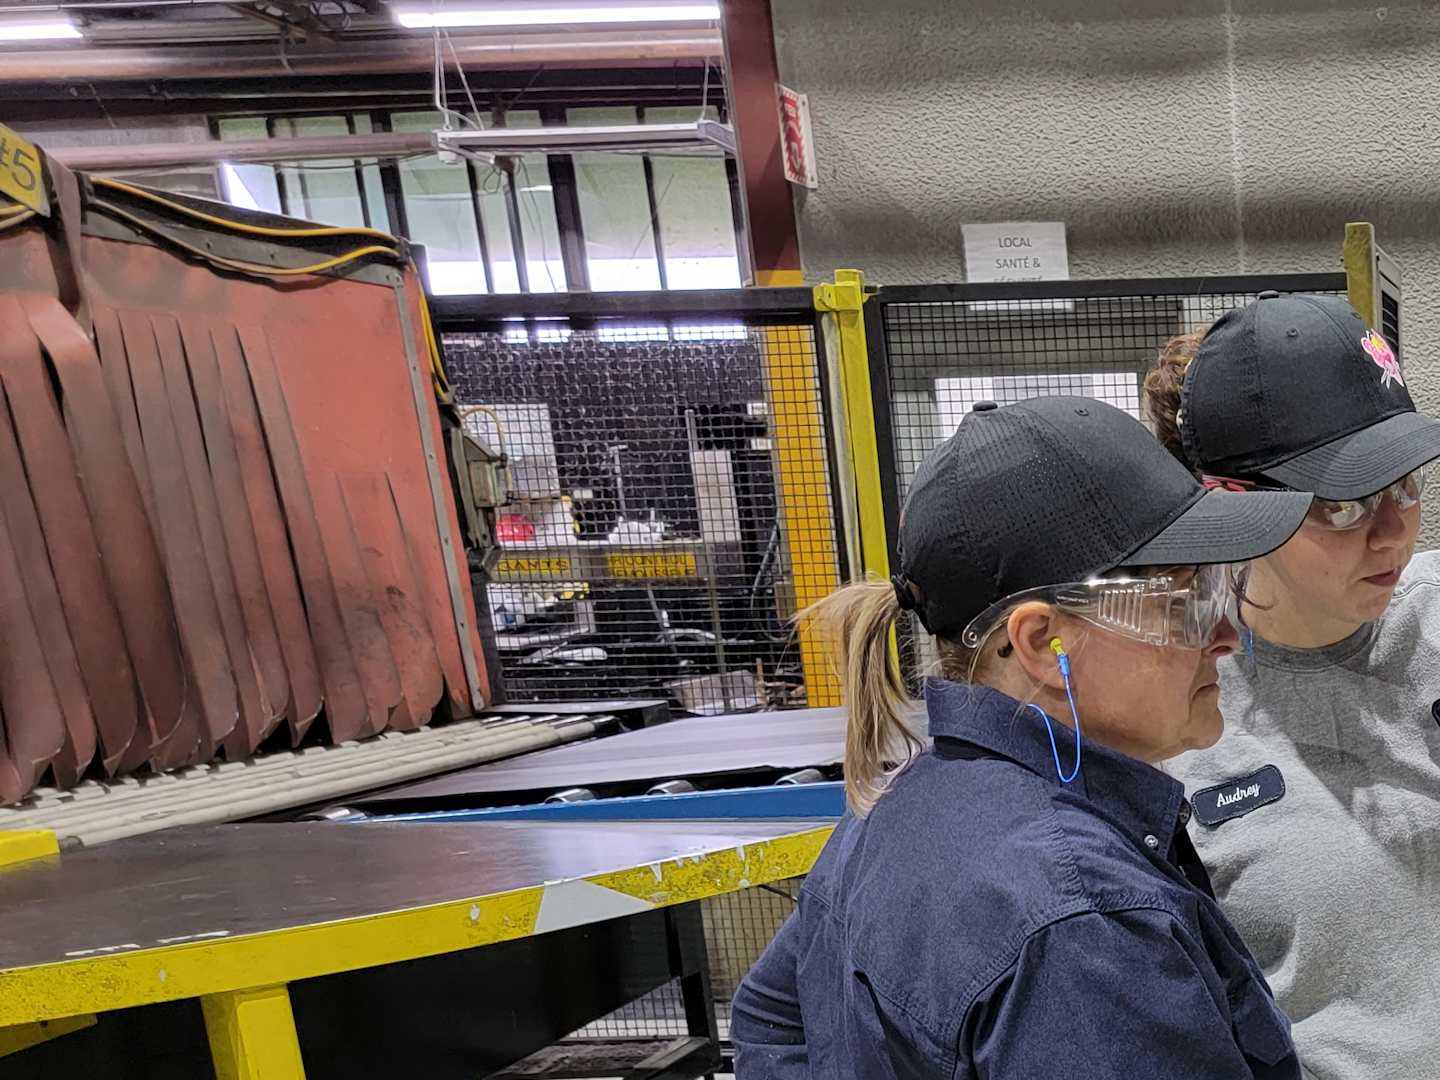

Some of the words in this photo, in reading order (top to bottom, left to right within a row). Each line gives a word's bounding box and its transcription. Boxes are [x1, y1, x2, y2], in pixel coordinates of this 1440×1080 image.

[998, 237, 1032, 248] LOCAL
[995, 256, 1029, 269] SANTÉ
[1032, 258, 1041, 268] &
[1216, 783, 1261, 808] Audrey
